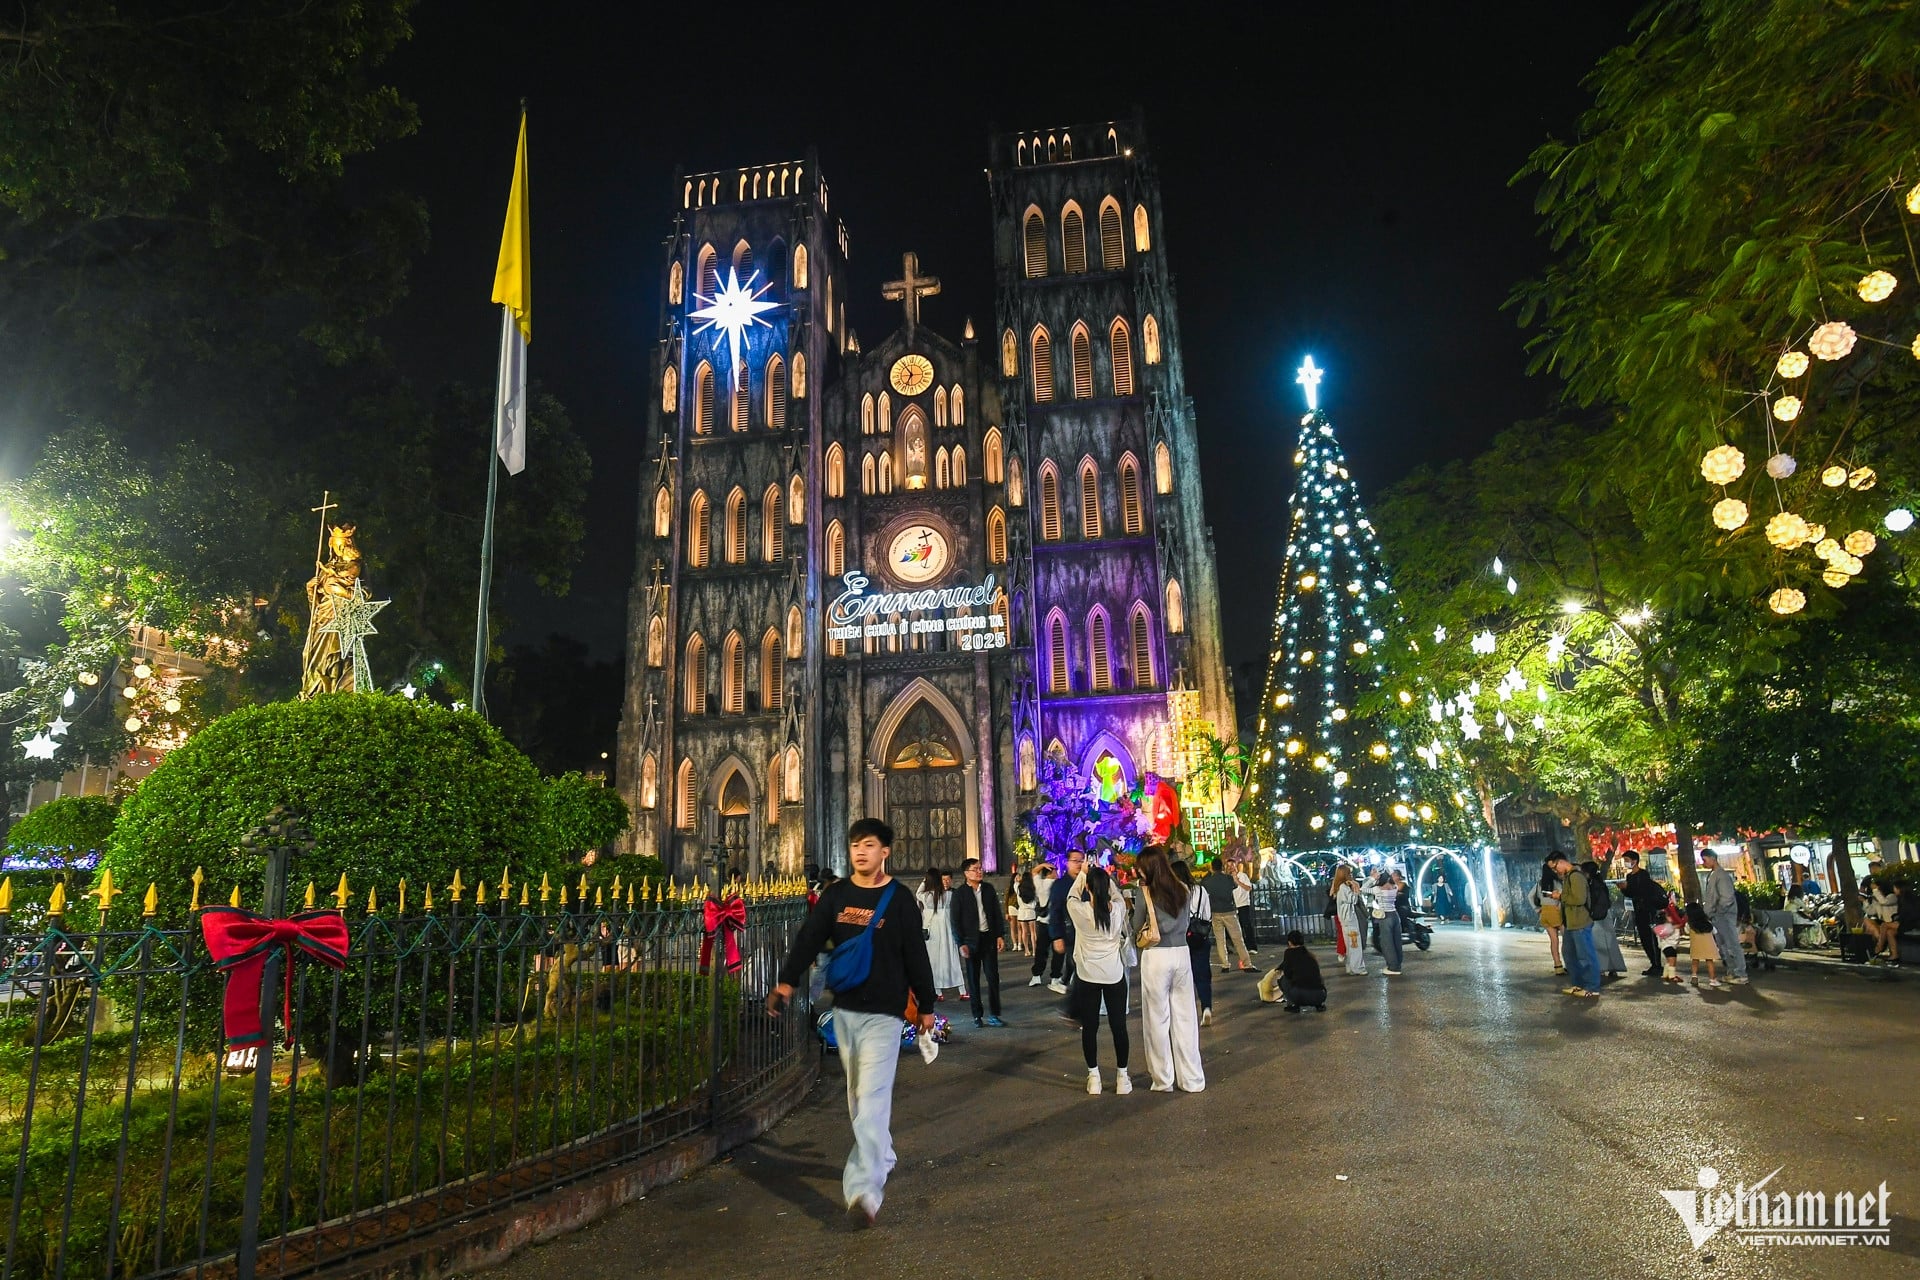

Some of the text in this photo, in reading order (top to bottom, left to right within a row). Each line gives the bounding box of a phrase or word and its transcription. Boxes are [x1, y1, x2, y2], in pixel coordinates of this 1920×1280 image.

[830, 570, 997, 624] Emmanuel
[827, 614, 1005, 640] THIÊN CHÚA Ở CÙNG CHÚNG TA
[961, 632, 1006, 651] 2025
